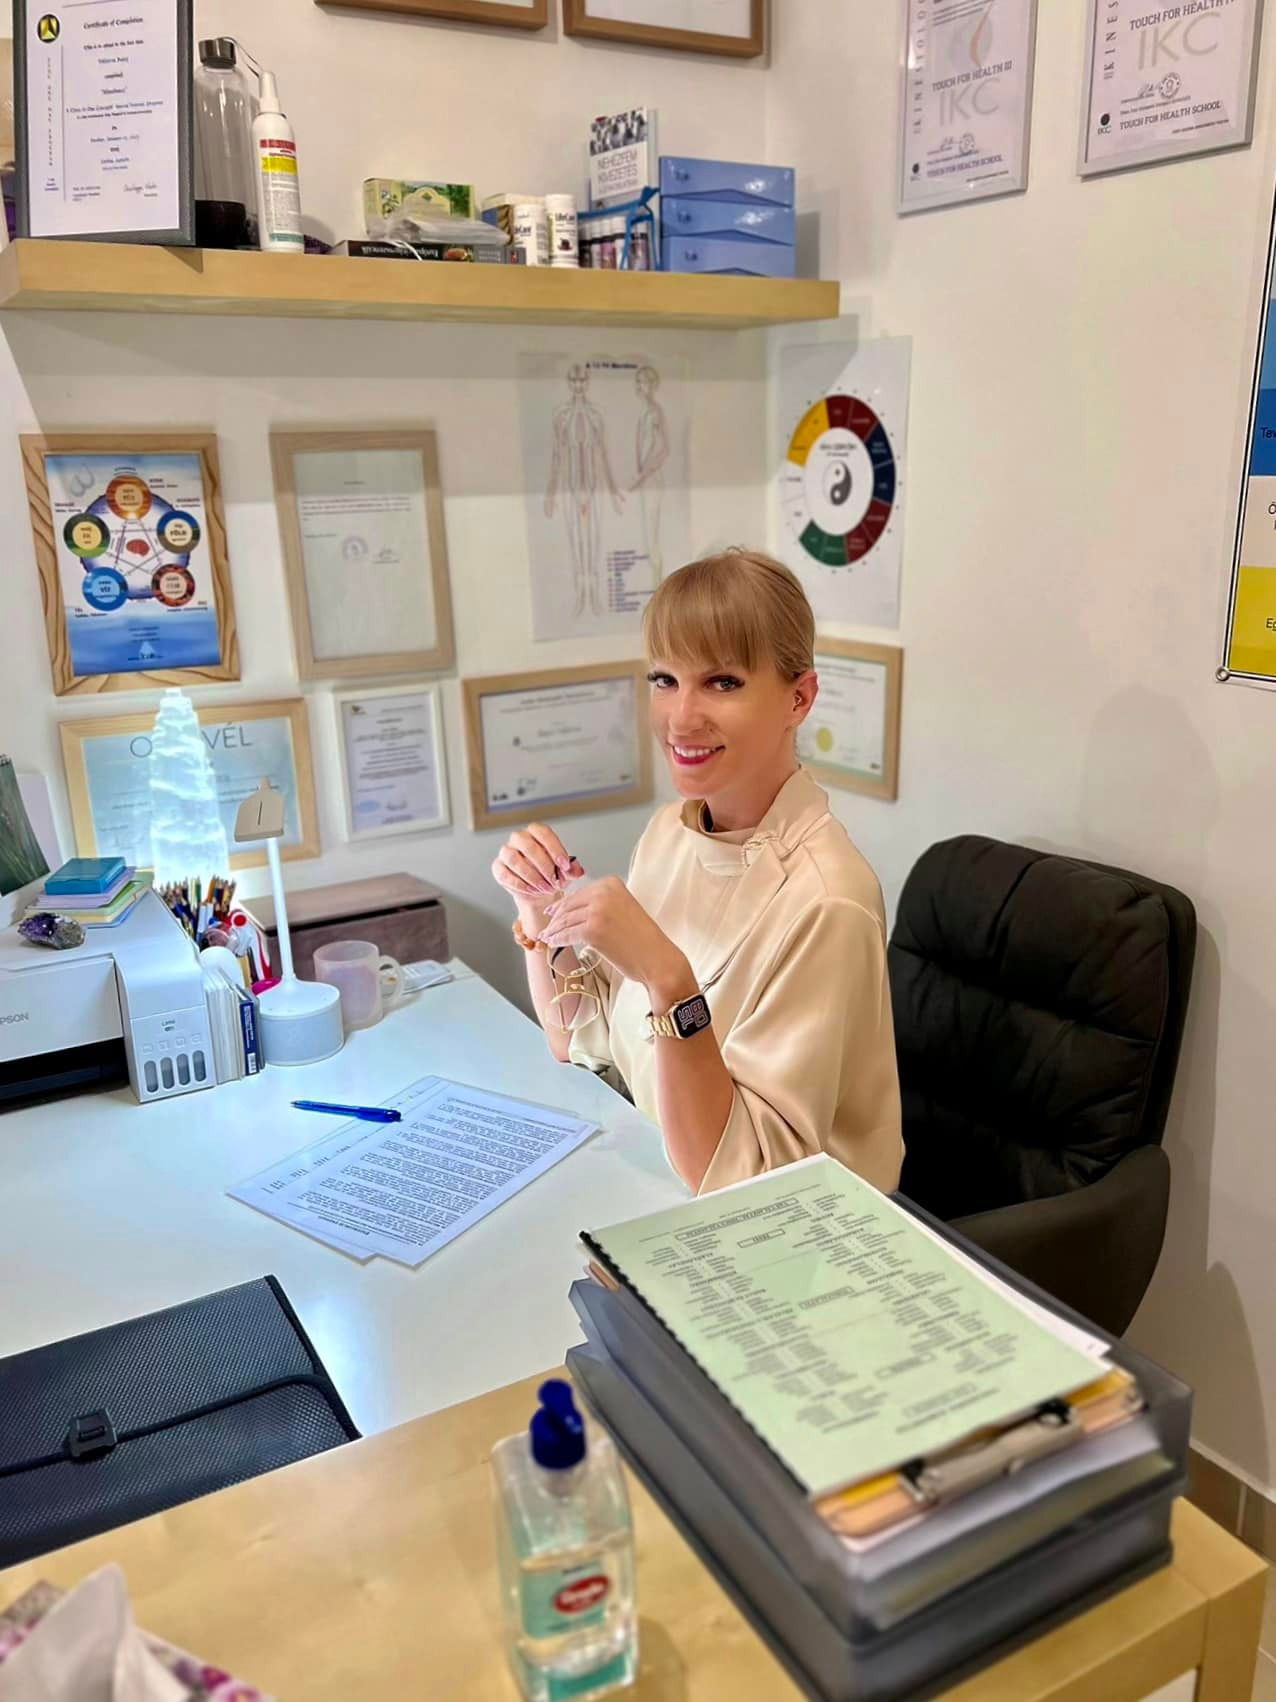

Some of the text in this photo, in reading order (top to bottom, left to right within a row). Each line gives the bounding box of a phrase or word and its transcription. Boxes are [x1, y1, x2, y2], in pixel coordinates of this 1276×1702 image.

[1129, 12, 1161, 31] TOUCH
[1162, 8, 1181, 22] FOR
[1138, 11, 1221, 70] IKC
[932, 77, 956, 92] TOUCH
[957, 72, 970, 84] FOR
[972, 63, 1003, 80] HEALTH
[940, 78, 1001, 127] IKC
[1120, 118, 1144, 130] TOUCH
[1144, 114, 1159, 125] FOR
[1160, 107, 1191, 121] HEALTH
[1192, 100, 1221, 114] SCHOOL
